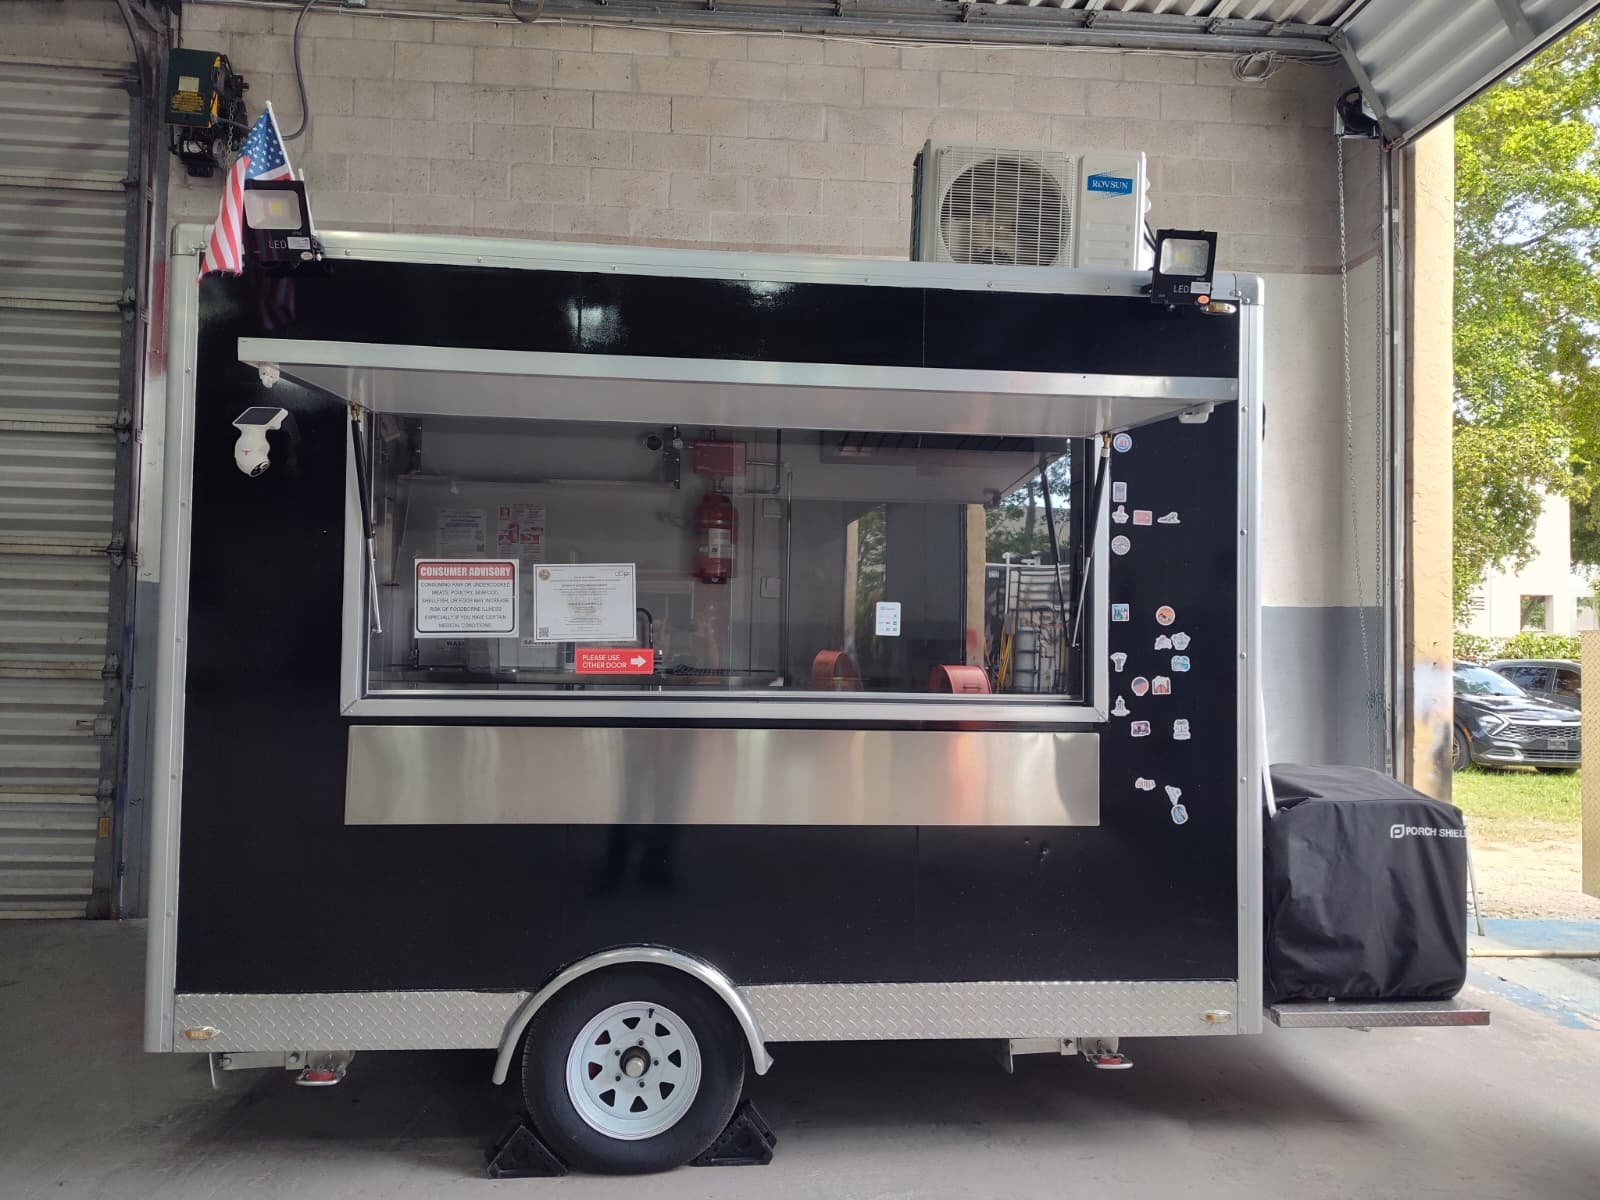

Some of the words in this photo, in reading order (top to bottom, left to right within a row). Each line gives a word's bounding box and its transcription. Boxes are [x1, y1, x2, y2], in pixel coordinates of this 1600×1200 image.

[1092, 179, 1129, 190] ROVSUN
[268, 240, 287, 249] LED
[1173, 284, 1190, 294] LED
[420, 566, 467, 577] CONSUMER
[468, 566, 511, 577] ADVISORY
[582, 661, 605, 669] OTHER
[1405, 826, 1437, 837] PORCH
